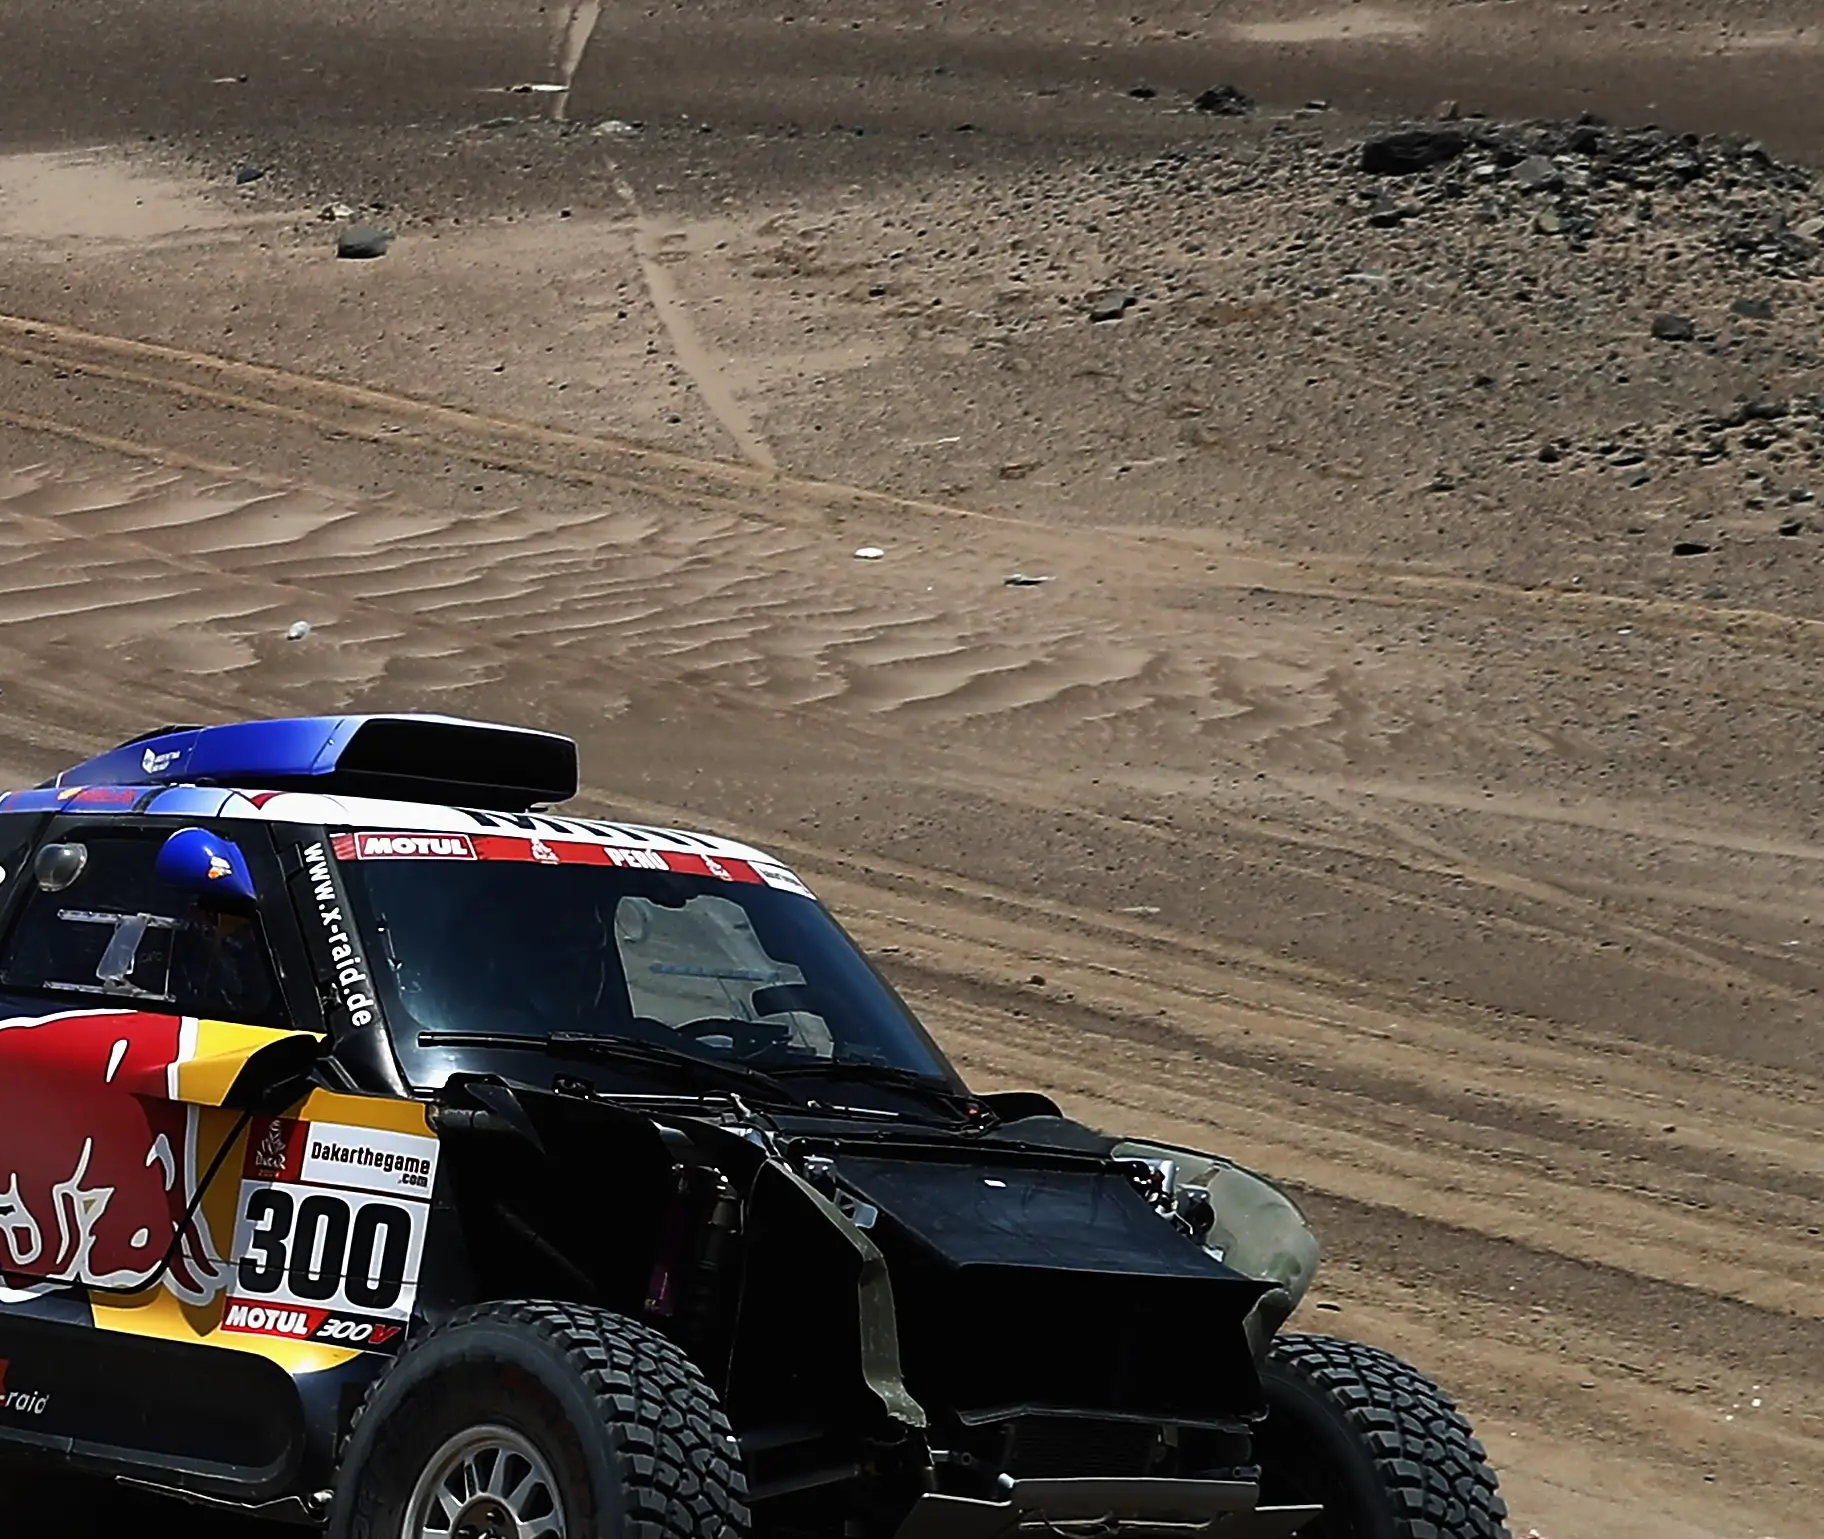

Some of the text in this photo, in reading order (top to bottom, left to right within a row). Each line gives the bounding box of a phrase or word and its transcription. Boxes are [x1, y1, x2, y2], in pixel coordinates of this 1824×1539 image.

[363, 837, 468, 857] MOTUL
[604, 848, 670, 871] PERU
[303, 841, 372, 1028] www.x-raid.de
[311, 1141, 431, 1175] Dakarthegame
[397, 1172, 429, 1188] .com
[238, 1188, 412, 1310] 300
[224, 1303, 401, 1343] MOTUL 300V
